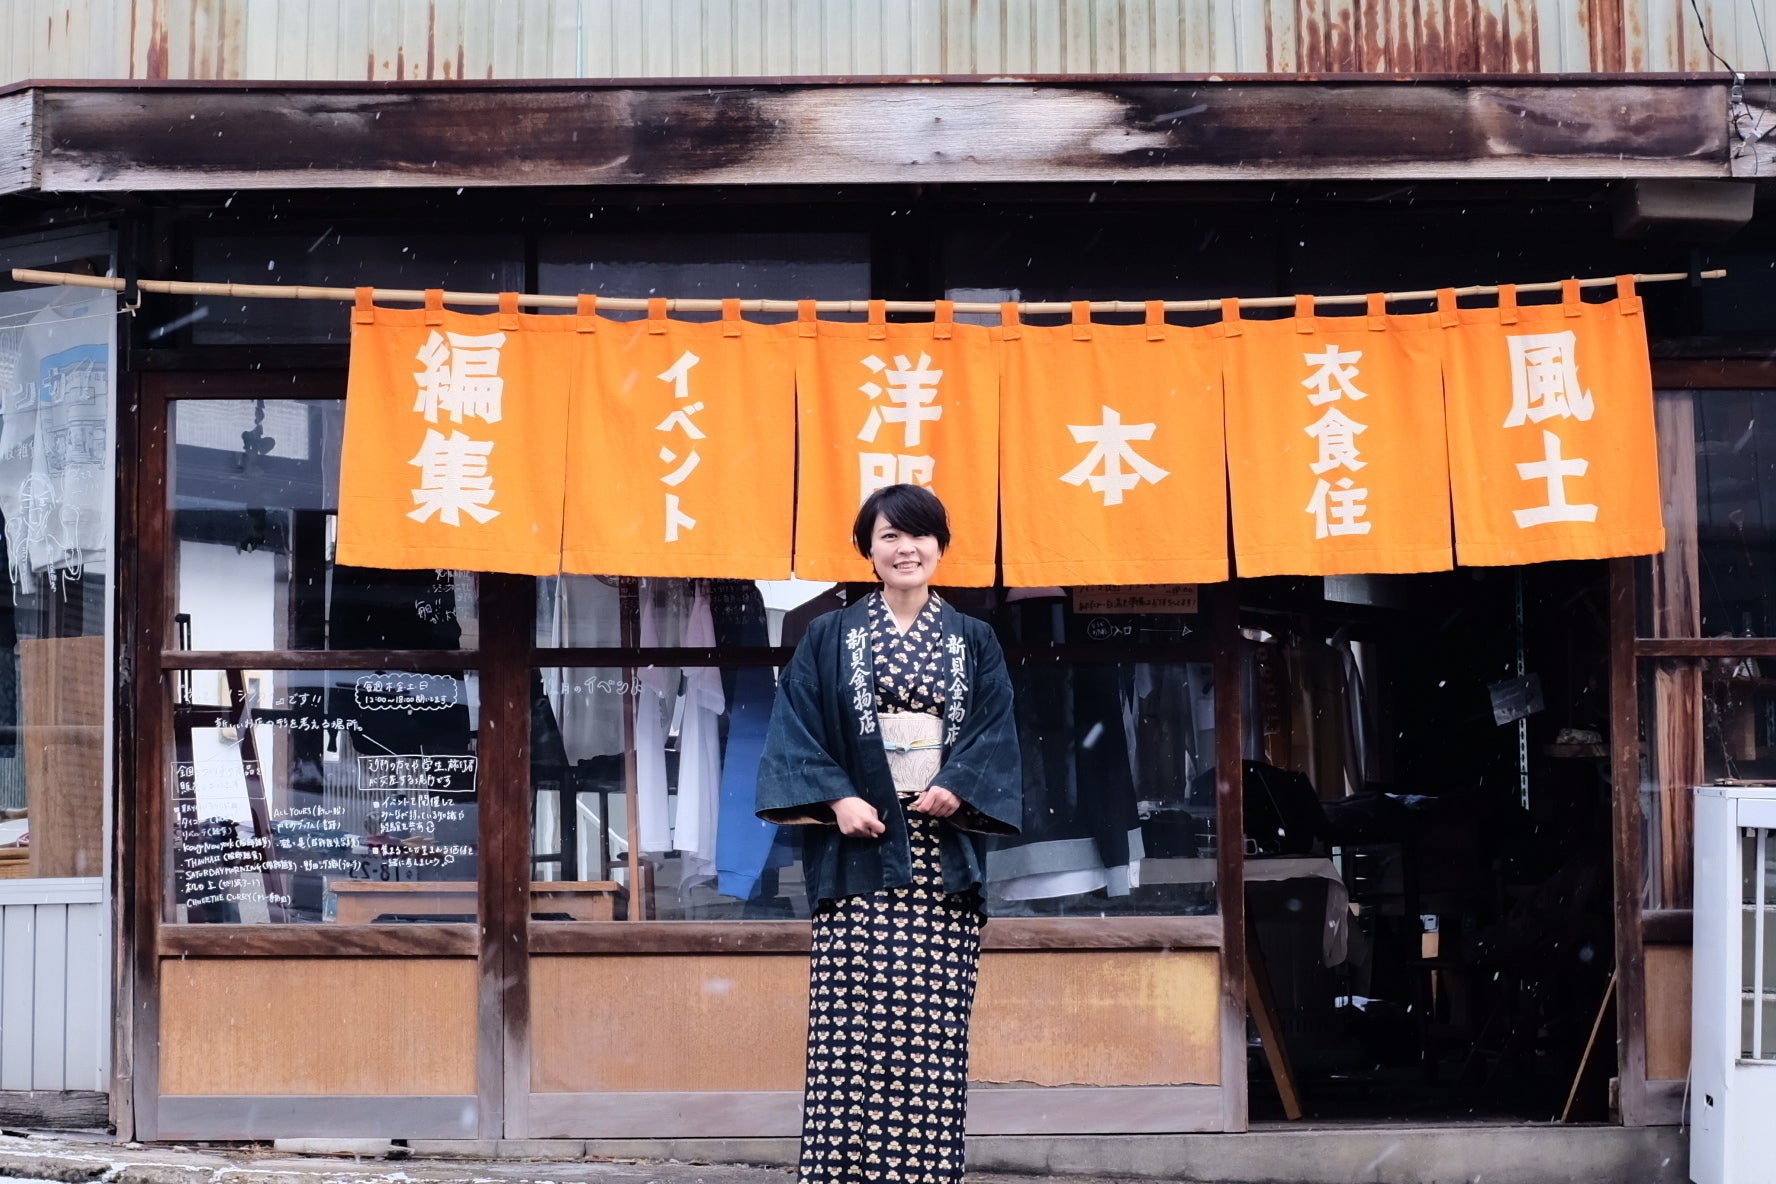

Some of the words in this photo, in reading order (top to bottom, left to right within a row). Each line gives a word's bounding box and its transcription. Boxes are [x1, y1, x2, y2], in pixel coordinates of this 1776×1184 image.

[406, 330, 507, 527] 編集
[655, 350, 707, 543] イベント
[1059, 404, 1171, 507] 本
[1301, 344, 1372, 540] 衣食住
[1502, 330, 1599, 529] 風土
